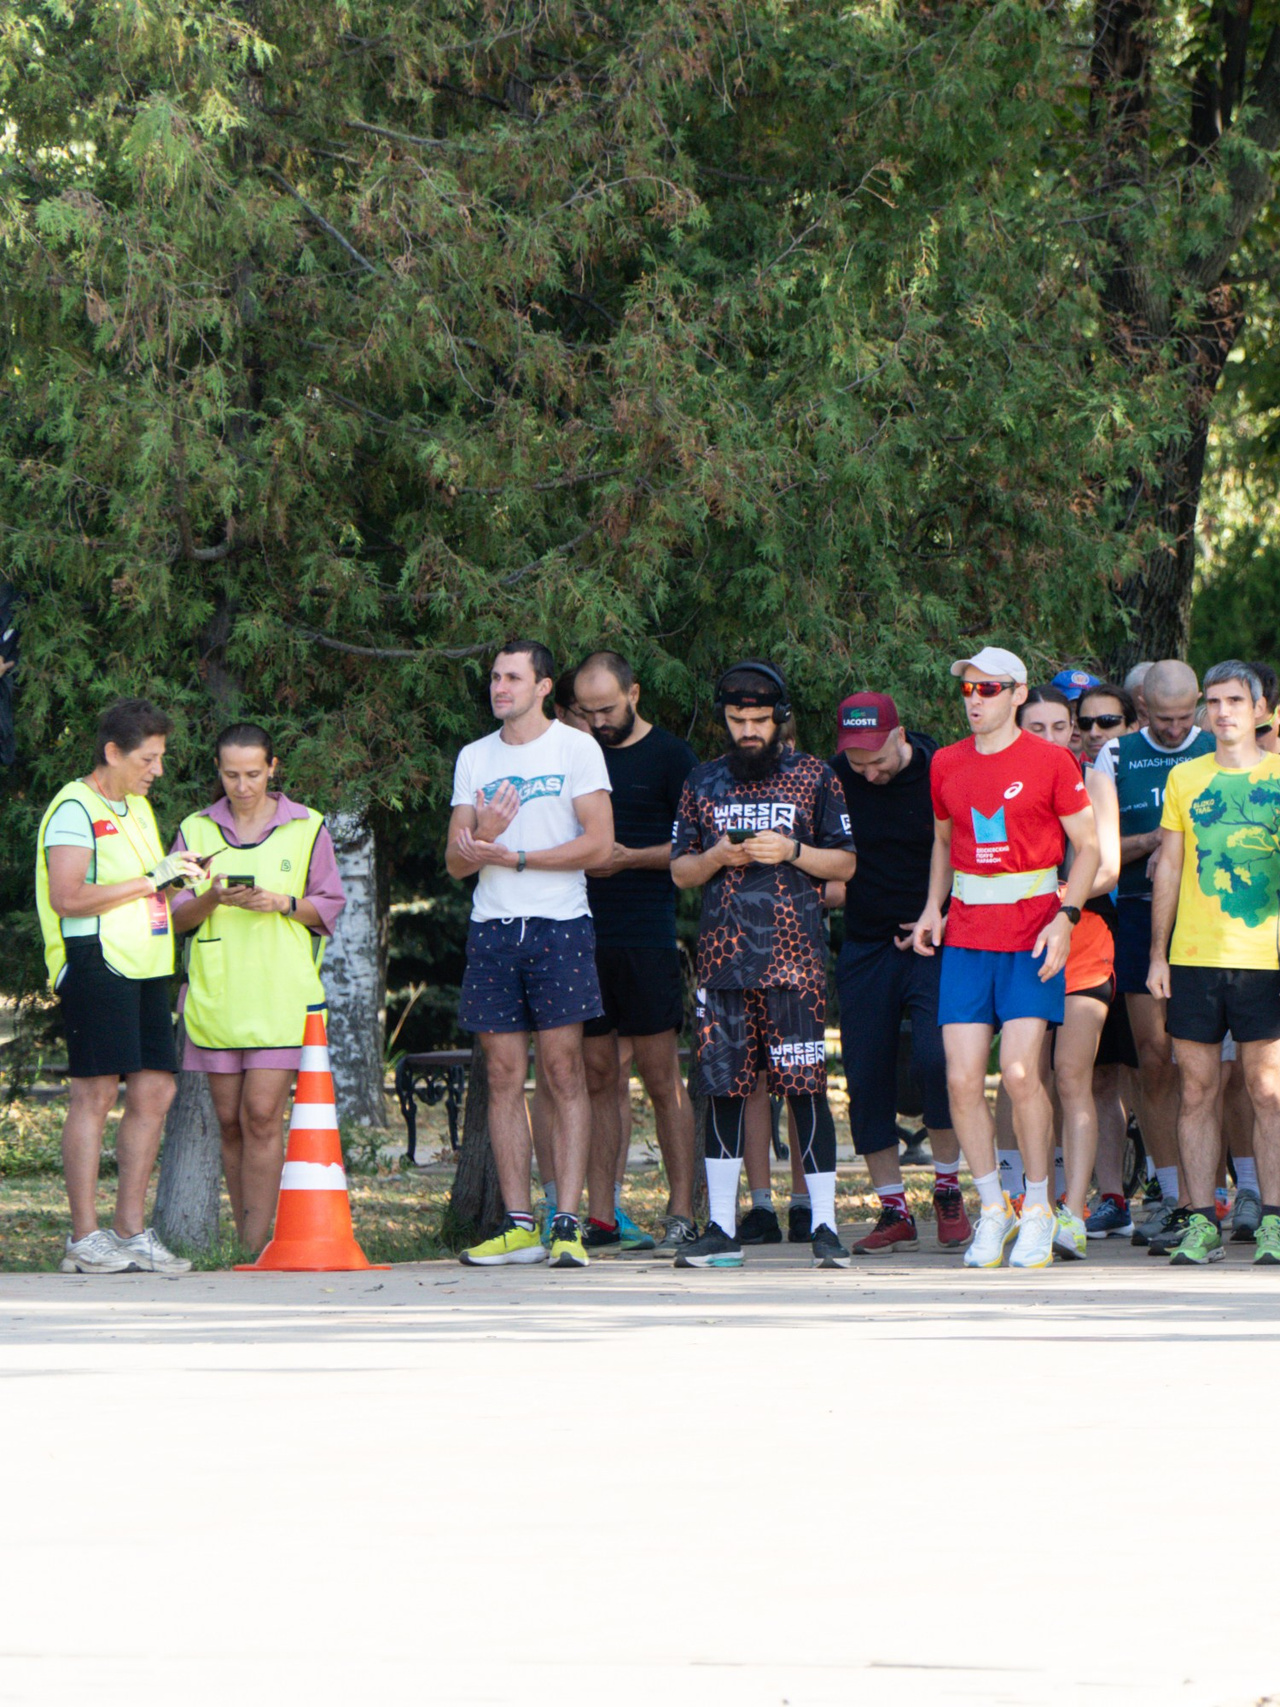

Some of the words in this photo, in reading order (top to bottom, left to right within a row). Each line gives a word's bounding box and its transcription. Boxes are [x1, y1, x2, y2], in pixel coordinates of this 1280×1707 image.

[843, 718, 877, 726] LACOSTE
[714, 803, 770, 818] WRES
[714, 817, 770, 832] TLING
[769, 1041, 815, 1056] WRES
[769, 1053, 817, 1068] TLING
